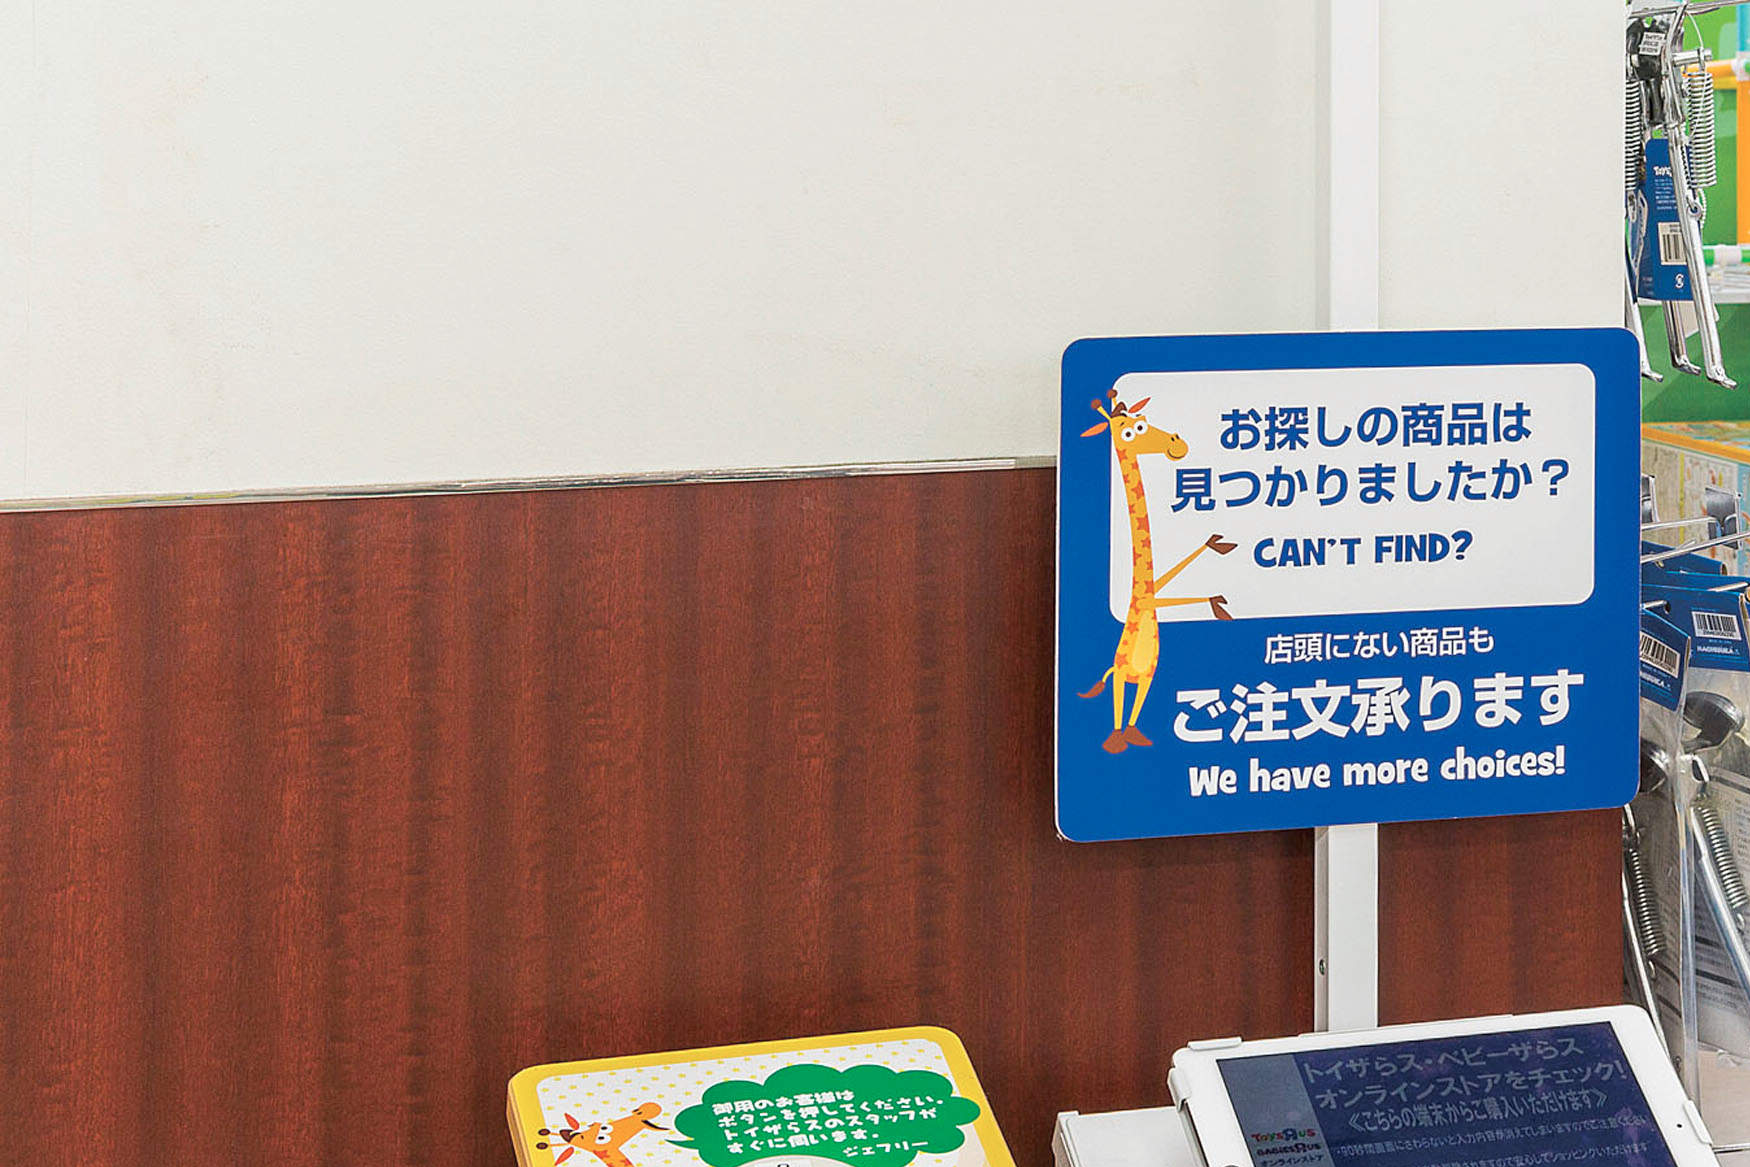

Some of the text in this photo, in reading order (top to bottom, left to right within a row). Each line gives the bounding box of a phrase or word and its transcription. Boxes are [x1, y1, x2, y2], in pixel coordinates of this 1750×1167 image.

[1219, 401, 1532, 451] お探しの商品は
[1171, 458, 1570, 512] 見つかりましたか?
[1253, 530, 1473, 568] CAN'T FIND?
[1264, 626, 1494, 665] 店頭にない商品も
[1172, 669, 1585, 744] ご注文承ります
[1188, 745, 1566, 797] We have more choices!
[1304, 1037, 1584, 1084] トイザらス・ベビーザらス
[712, 1089, 855, 1115] 御用のお客様は
[1316, 1060, 1627, 1110] オンラインストアをチェック!
[725, 1107, 937, 1141] トイザらスのスタッフが
[727, 1129, 879, 1154] すぐに伺います。
[843, 1141, 929, 1157] ジェフリー
